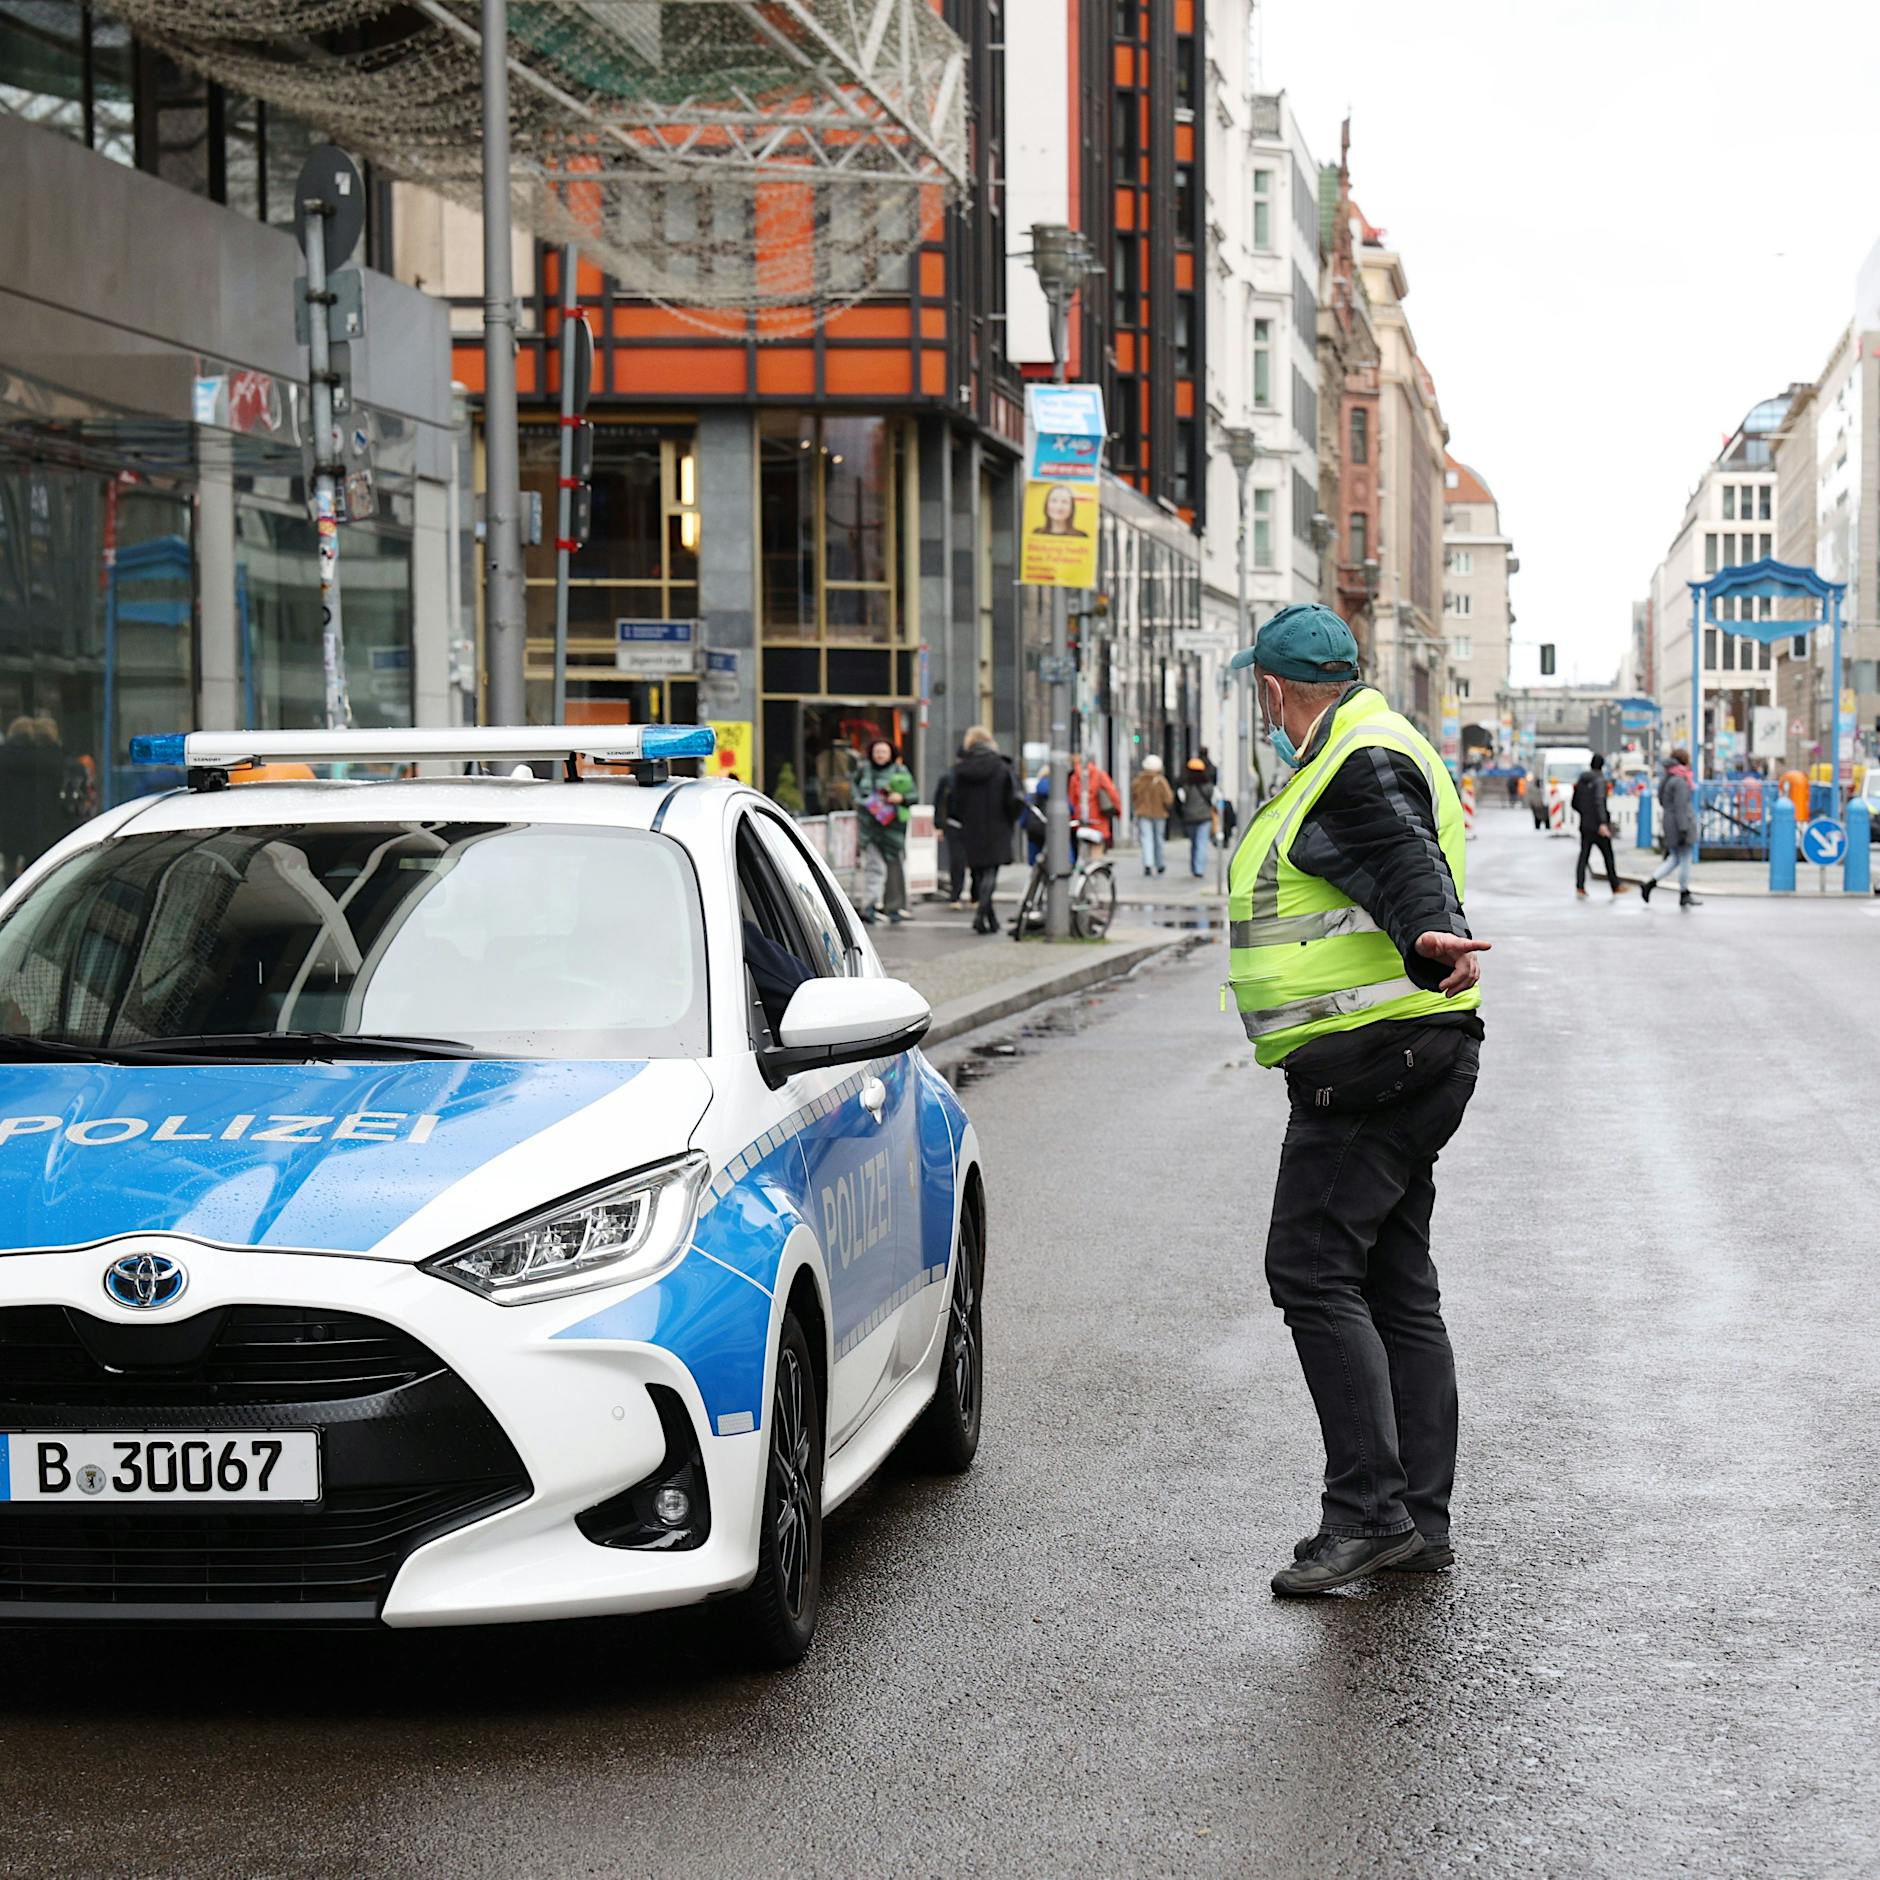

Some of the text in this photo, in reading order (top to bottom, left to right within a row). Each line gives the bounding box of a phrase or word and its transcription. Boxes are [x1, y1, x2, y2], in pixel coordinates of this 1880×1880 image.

[0, 1110, 442, 1146] POLIZEI
[821, 1147, 892, 1280] POLIZEI
[37, 1440, 283, 1493] B 30067
